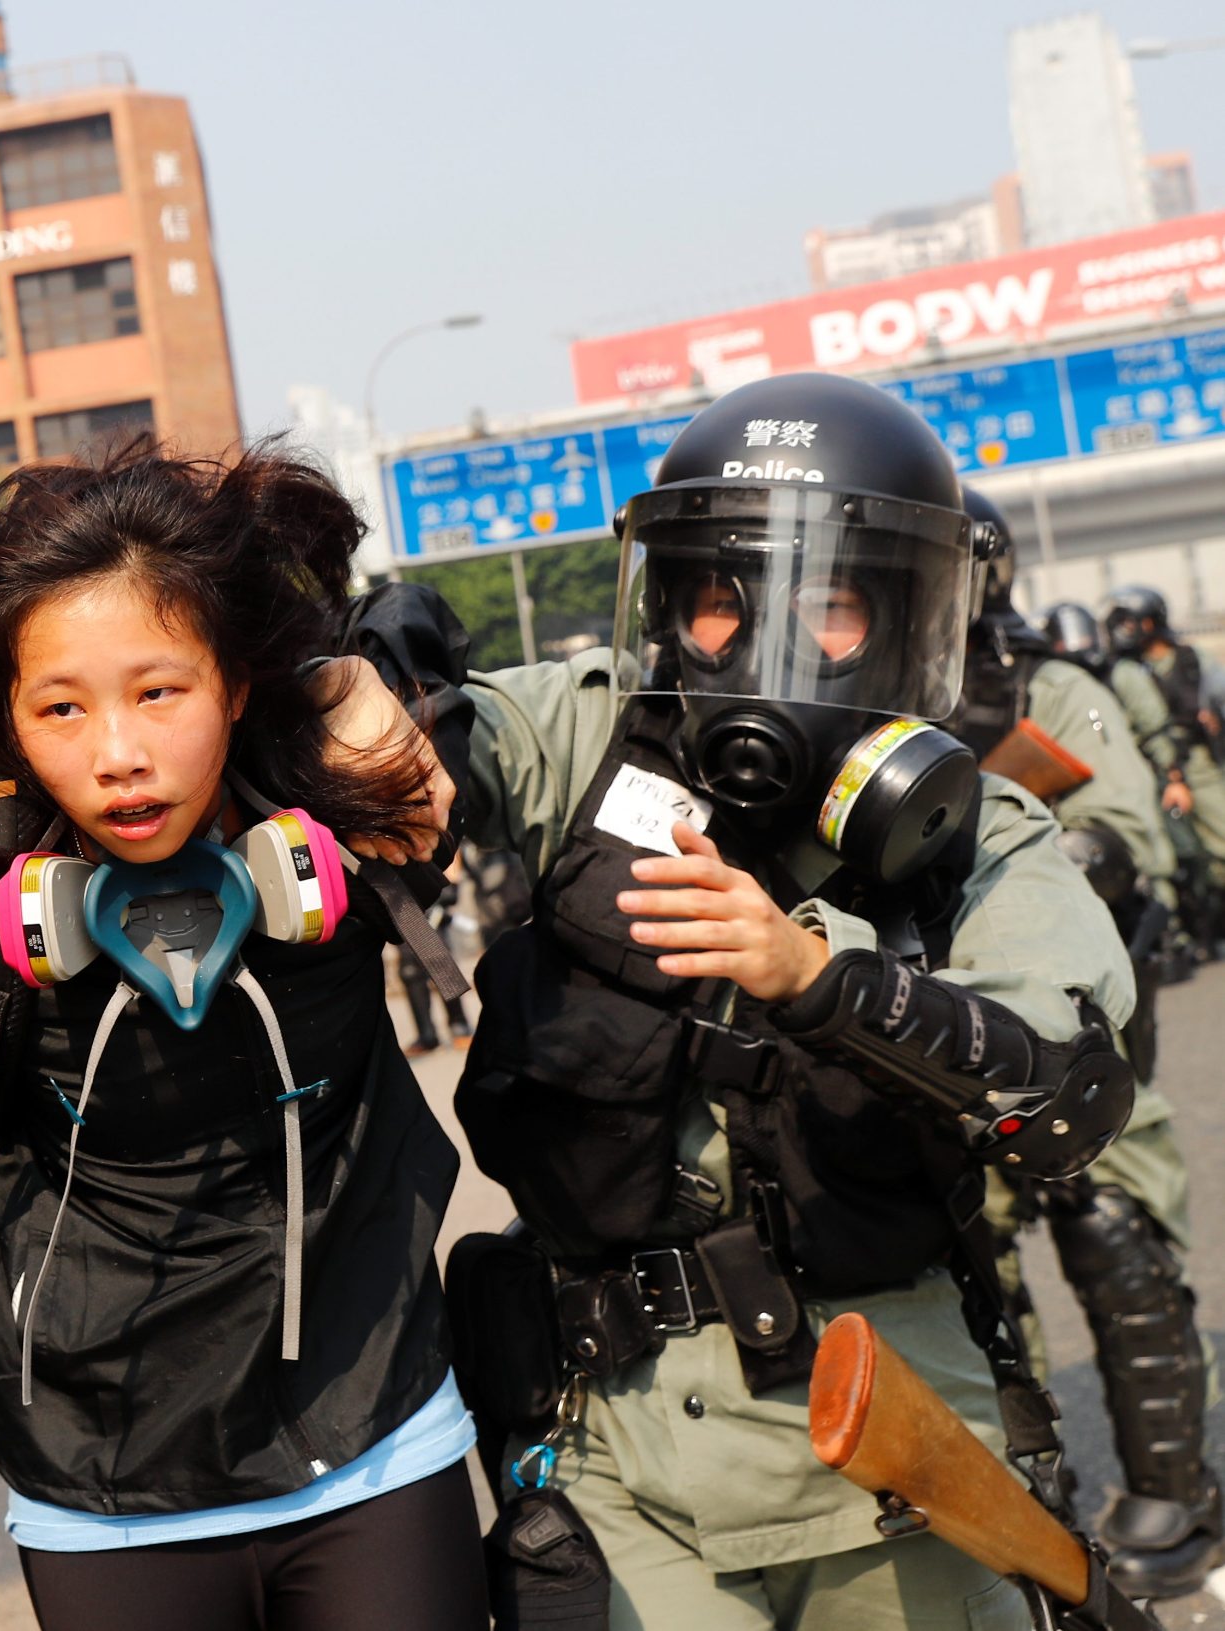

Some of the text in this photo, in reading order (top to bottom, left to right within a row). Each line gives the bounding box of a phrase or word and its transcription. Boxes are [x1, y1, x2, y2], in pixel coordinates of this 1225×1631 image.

[1077, 236, 1219, 287] BUSINESS
[810, 267, 1054, 368] BODW
[742, 418, 819, 448] 警察
[722, 460, 825, 483] Police
[626, 776, 670, 804] PTU
[630, 812, 660, 833] 3/2
